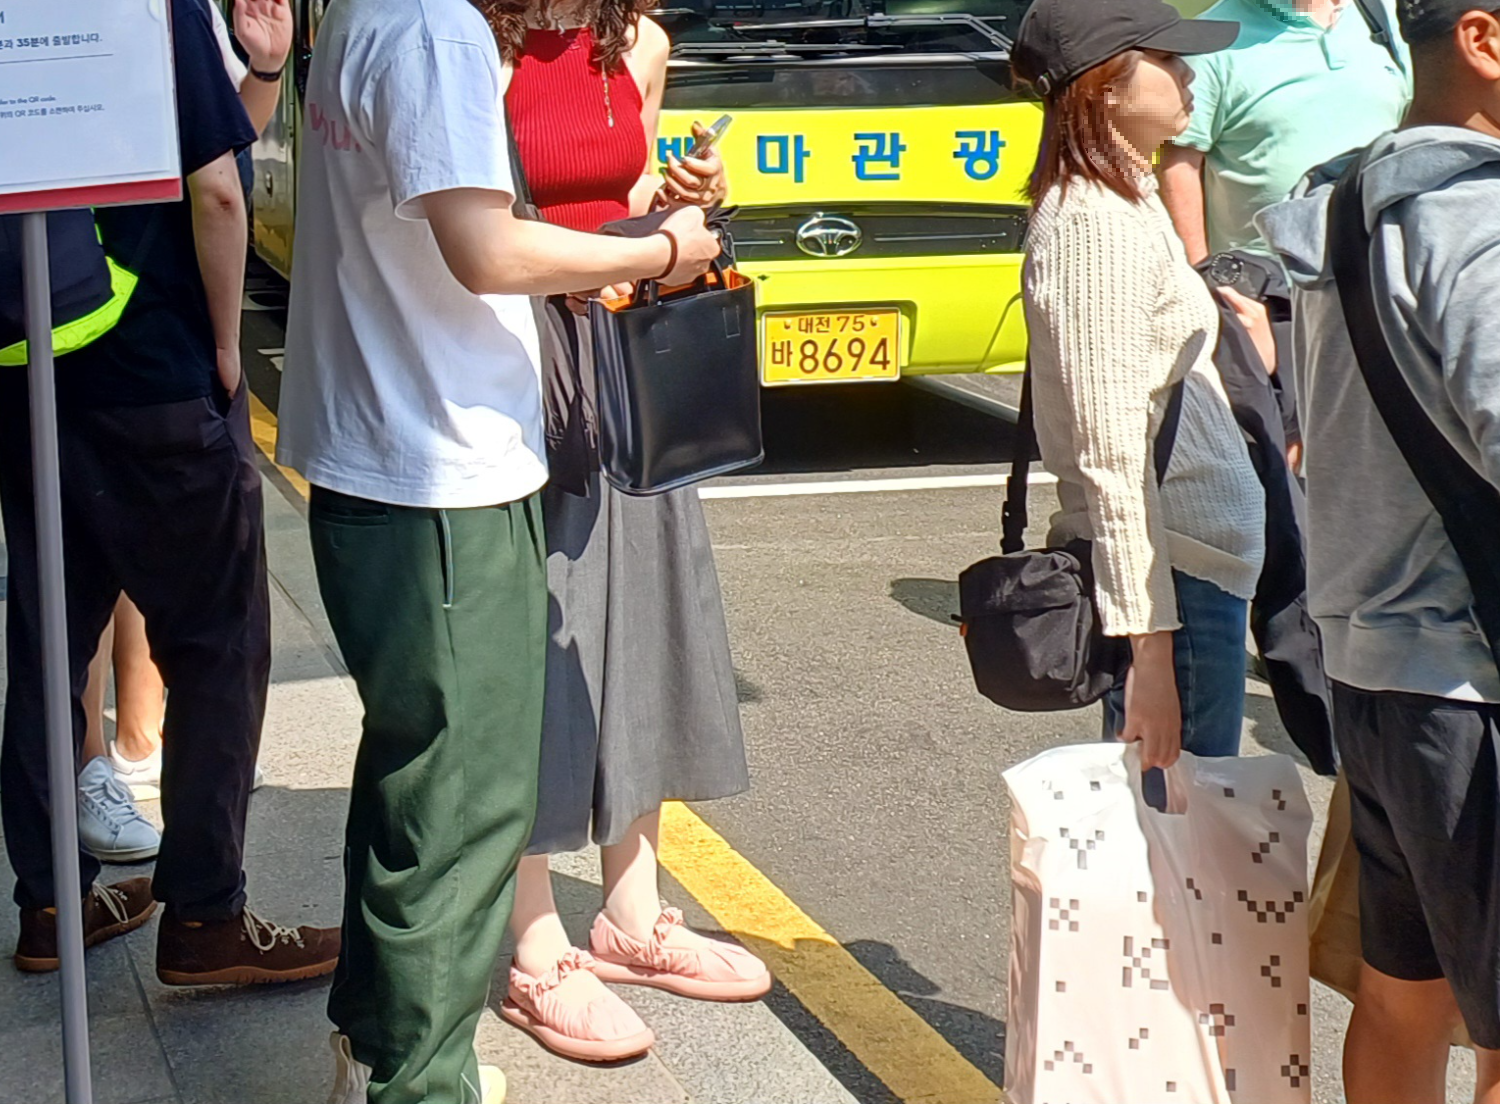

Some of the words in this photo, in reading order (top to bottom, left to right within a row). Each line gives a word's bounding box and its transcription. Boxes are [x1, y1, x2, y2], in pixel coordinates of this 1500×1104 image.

[16, 36, 49, 48] 35분에
[798, 316, 830, 333] 대전
[836, 314, 865, 332] 75
